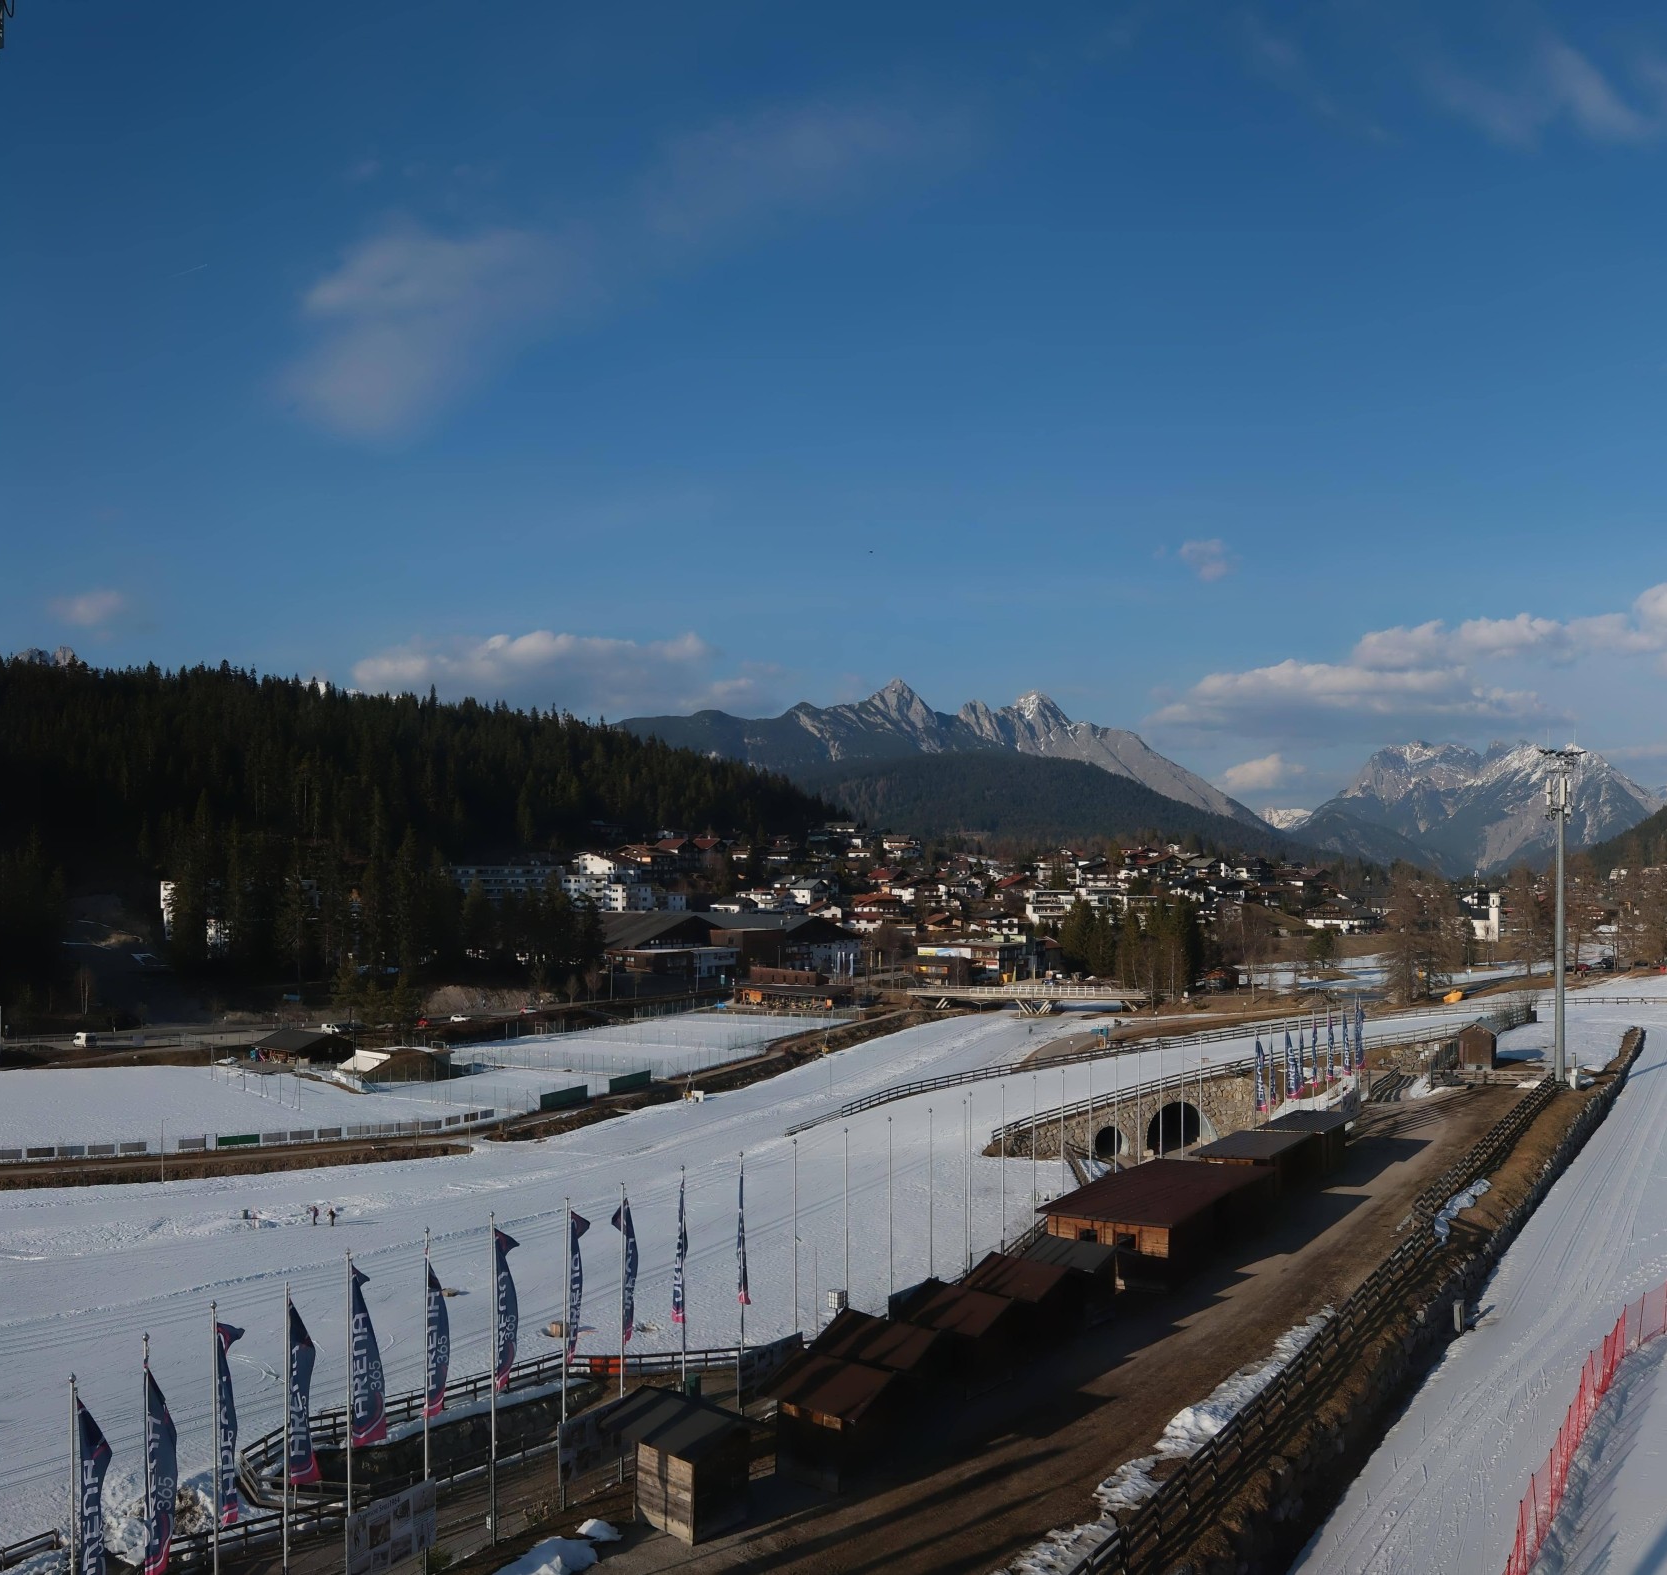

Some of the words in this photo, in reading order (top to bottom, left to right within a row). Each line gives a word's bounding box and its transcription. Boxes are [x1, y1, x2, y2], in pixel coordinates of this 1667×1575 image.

[1288, 1047, 1296, 1089] ARENA
[505, 1314, 516, 1341] 365
[352, 1312, 367, 1419] ARENA
[436, 1335, 448, 1364] 365
[368, 1360, 382, 1391] 365
[156, 1476, 175, 1511] 365
[83, 1459, 99, 1575] RENA
